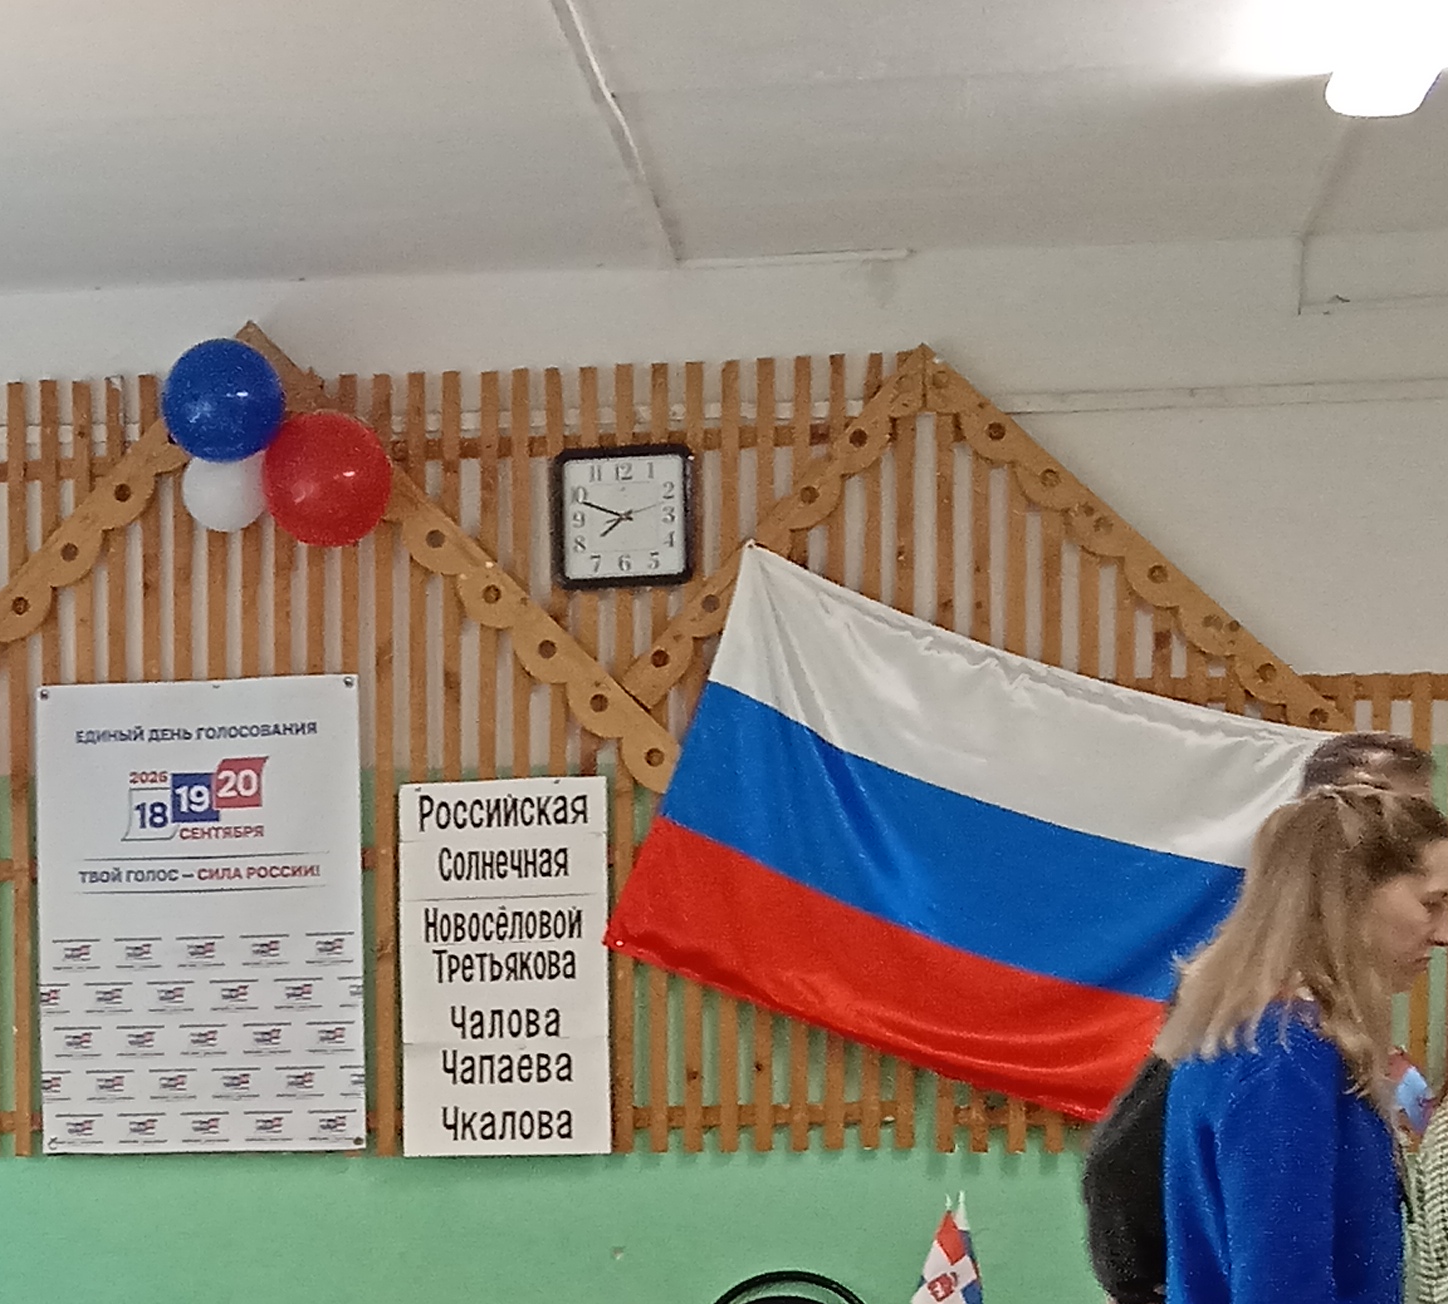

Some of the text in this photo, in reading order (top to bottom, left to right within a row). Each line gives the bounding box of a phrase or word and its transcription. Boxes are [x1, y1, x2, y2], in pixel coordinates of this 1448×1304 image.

[615, 462, 633, 481] 12
[647, 462, 654, 479] 1
[663, 481, 675, 499] 2
[573, 511, 585, 528] 9
[662, 506, 675, 524] 3
[573, 535, 586, 553] 8
[590, 555, 601, 573] 7
[618, 555, 631, 571] 6
[76, 722, 317, 744] ЕДИНЫЙ ДЕНЬ ГОЛОСОВАНИЯ
[218, 769, 258, 798] 20
[175, 785, 210, 813] 19
[135, 802, 168, 829] 18
[419, 794, 588, 831] Российская
[179, 825, 264, 841] СЕНТЯБРЯ
[78, 870, 122, 884] ТВОЙ
[125, 869, 179, 883] ГОЛОС
[197, 867, 242, 880] СИЛА
[246, 864, 321, 879] РОССИИ!
[439, 847, 569, 881] Солнечная
[424, 905, 582, 942] Новосёловой
[433, 949, 576, 983] Третьякова
[450, 1006, 560, 1039] Чалова
[442, 1050, 574, 1085] Чапаева
[442, 1106, 574, 1141] Чкалова
